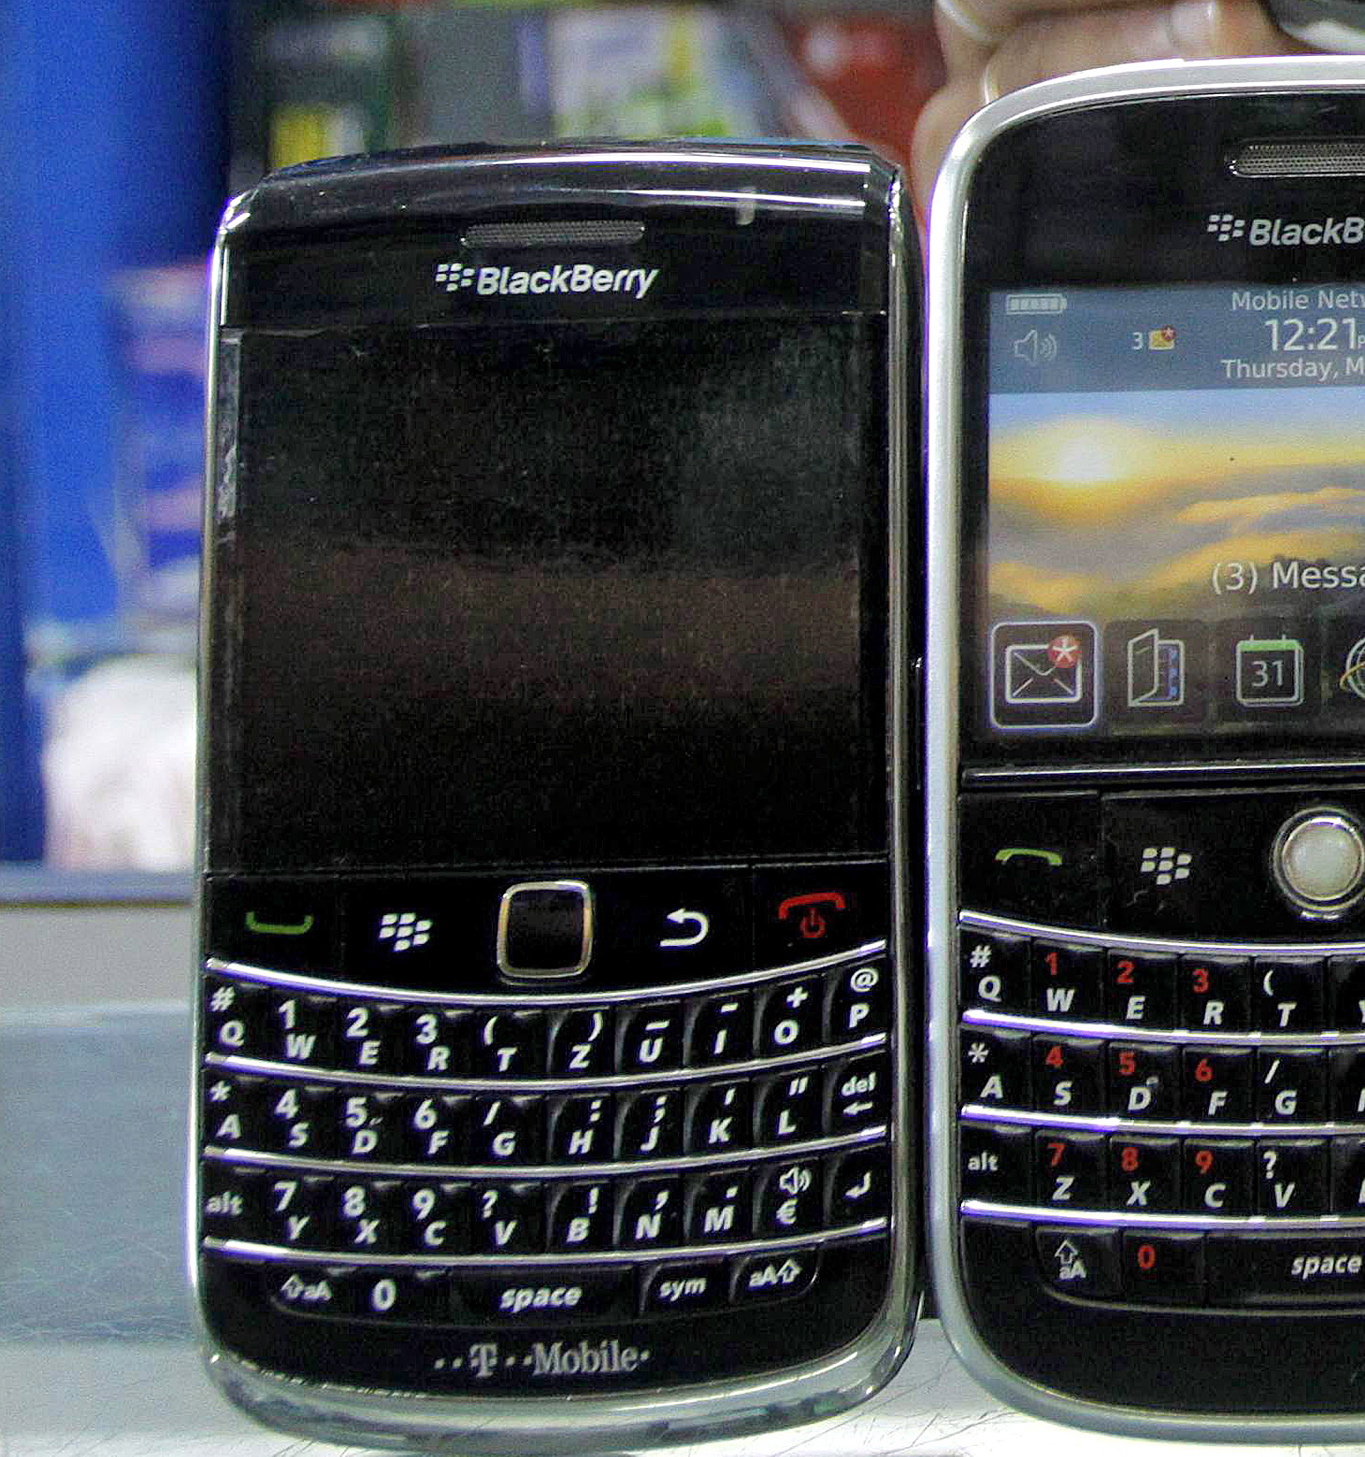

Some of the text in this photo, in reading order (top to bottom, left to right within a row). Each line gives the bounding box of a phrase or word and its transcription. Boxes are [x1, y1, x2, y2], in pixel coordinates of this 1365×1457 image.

[477, 264, 658, 299] BlackBerry
[1231, 290, 1310, 312] Mobile
[1131, 332, 1143, 350] 3
[1221, 358, 1340, 382] Thursday,
[1211, 561, 1260, 594] (3)
[1252, 660, 1283, 687] 31
[1045, 952, 1209, 992] 1 2 3
[977, 975, 1001, 1003] Q
[1046, 988, 1076, 1012] W
[1125, 995, 1146, 1020] E
[1203, 1001, 1225, 1025] R
[1277, 1002, 1297, 1027] T
[219, 1002, 870, 1072] Q W E R T Z U I O P
[279, 1000, 437, 1045] 1 2 3
[1046, 1046, 1212, 1081] 4 5 6
[841, 1072, 875, 1096] del
[979, 1074, 1004, 1099] A
[1053, 1081, 1073, 1106] S
[1127, 1086, 1152, 1111] D
[1207, 1090, 1228, 1116] F
[1274, 1089, 1297, 1115] G
[274, 1089, 436, 1130] 4 5 6
[216, 1109, 797, 1156] A S D F G H J K L
[968, 1152, 997, 1171] alt
[1048, 1143, 1213, 1173] 7 8 9
[204, 1191, 242, 1215] alt
[274, 1182, 435, 1219] 7 8 9
[1051, 1176, 1075, 1201] Z
[1126, 1180, 1151, 1206] X
[1204, 1183, 1226, 1208] C
[1274, 1183, 1295, 1208] V
[288, 1205, 735, 1246] Y X C V B N M
[1137, 1244, 1156, 1270] 0
[1291, 1256, 1362, 1279] space
[372, 1279, 397, 1311] 0
[499, 1287, 581, 1313] space
[659, 1278, 706, 1301] sym
